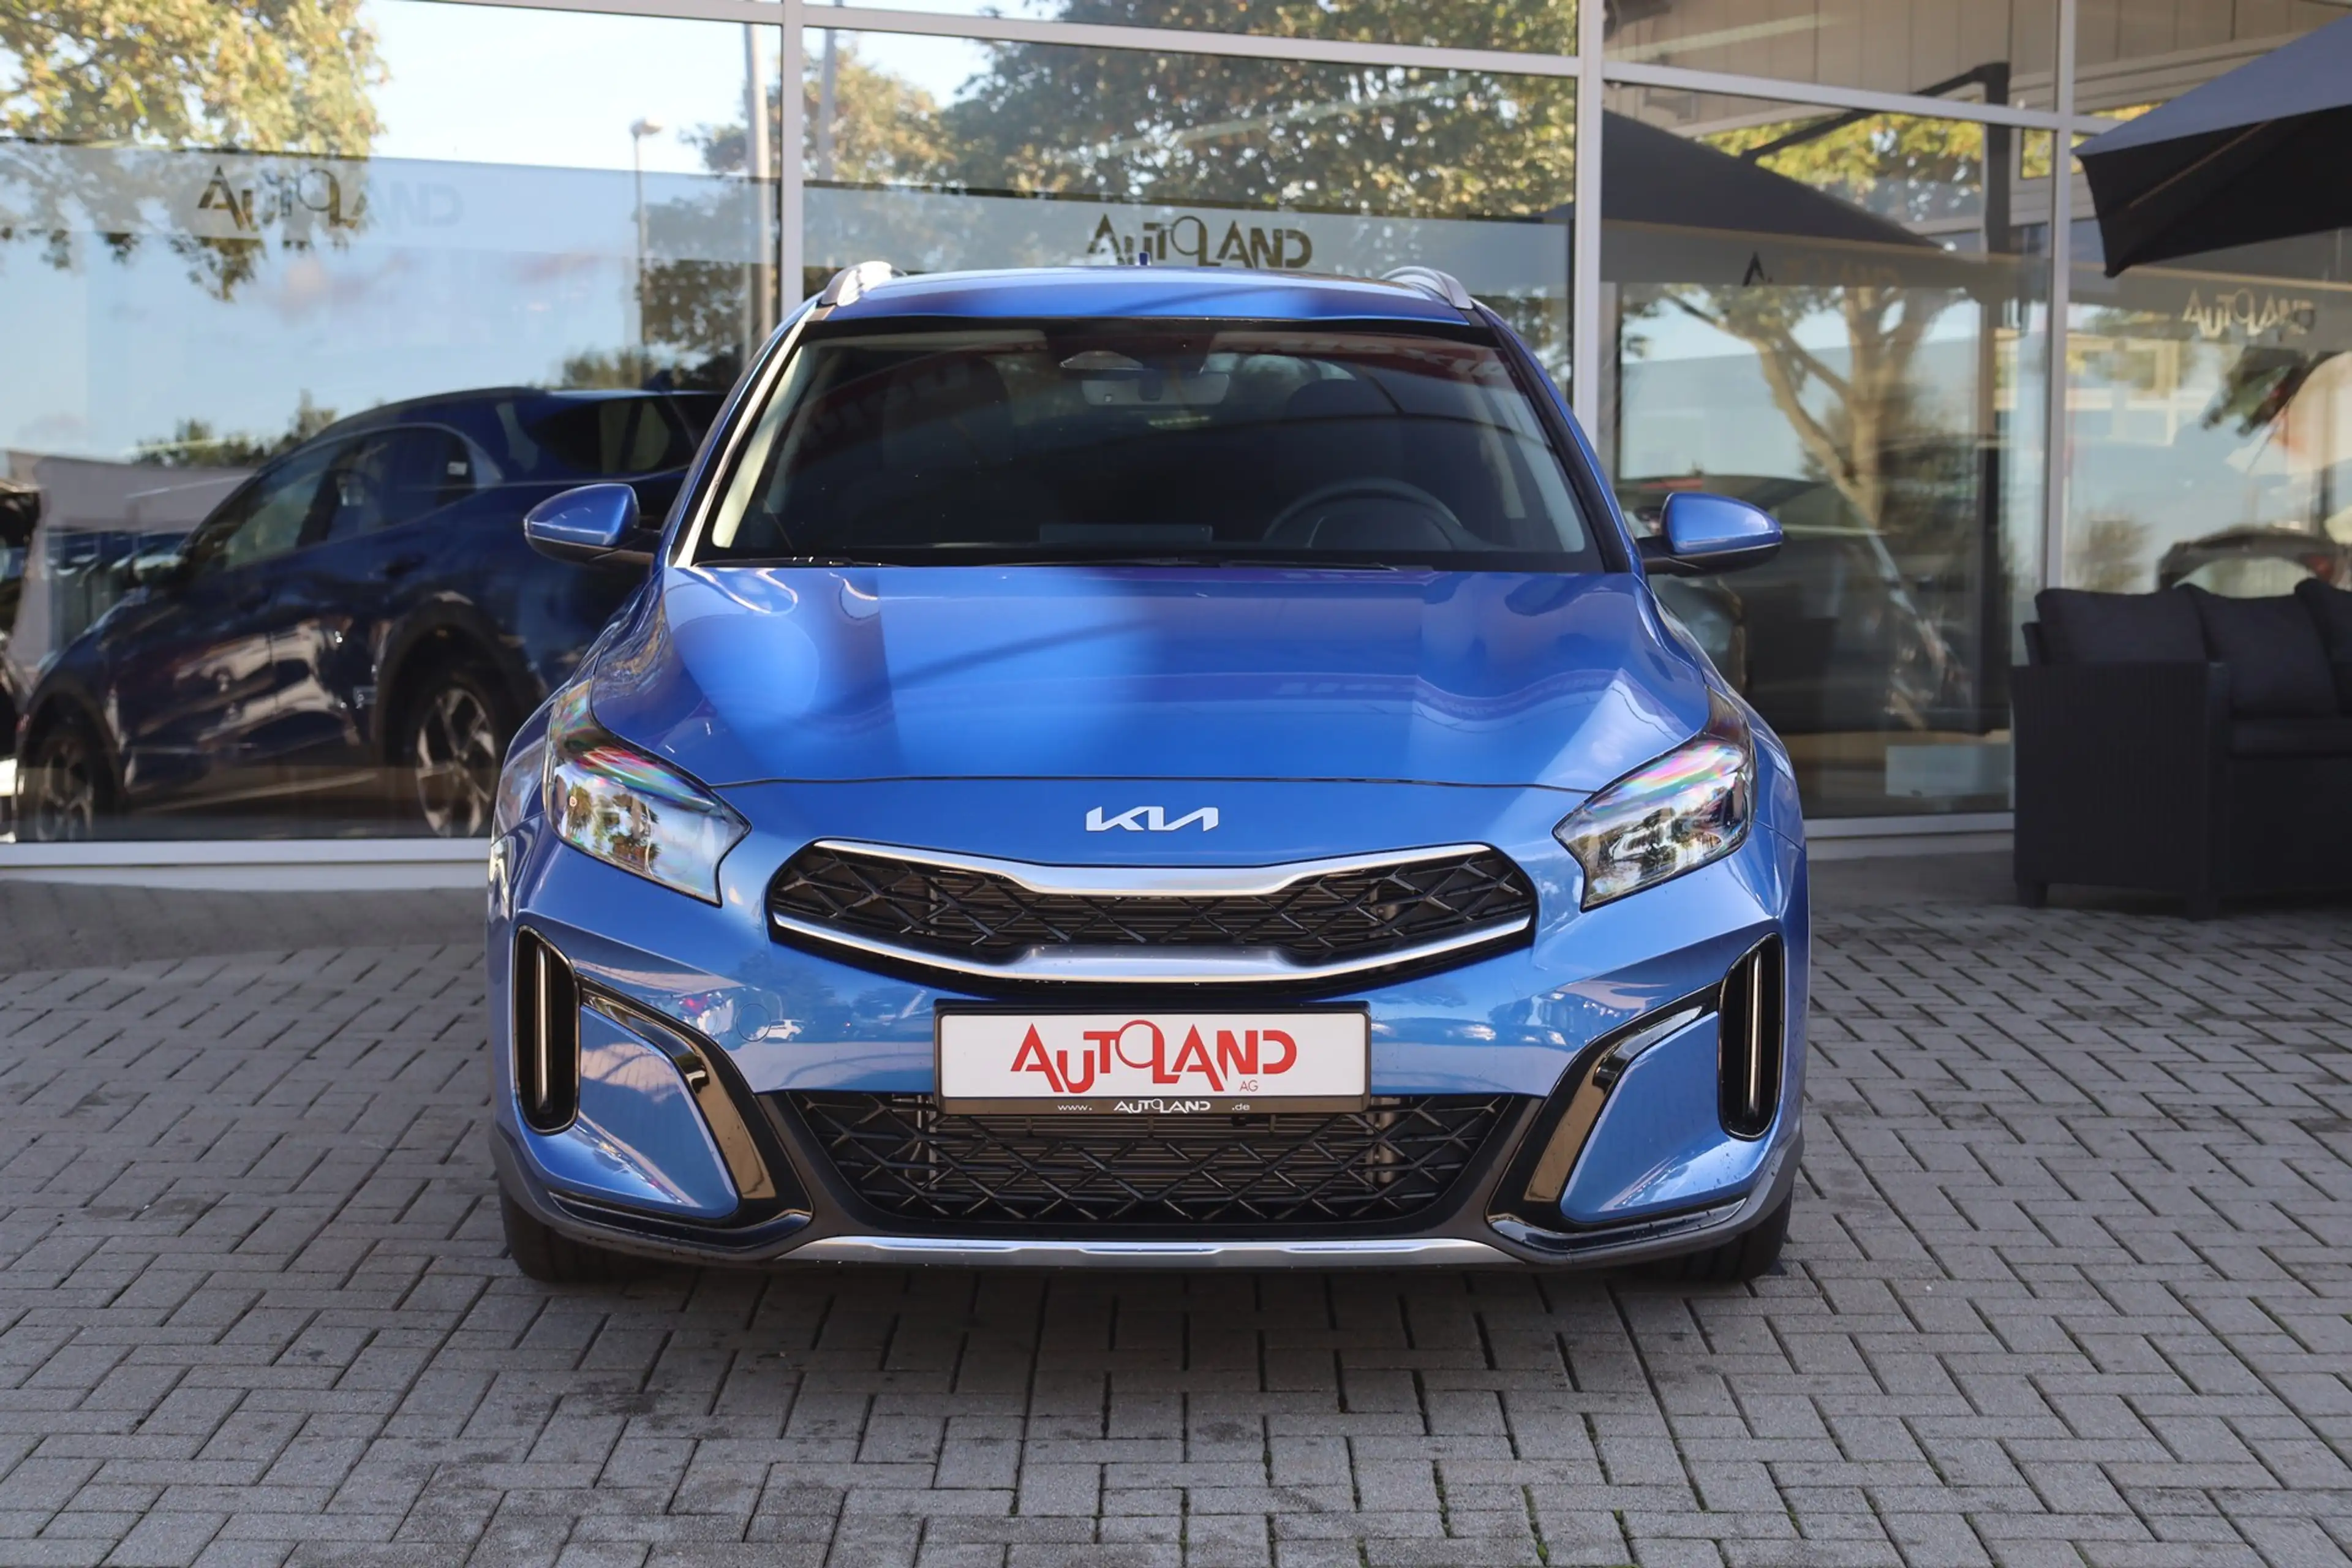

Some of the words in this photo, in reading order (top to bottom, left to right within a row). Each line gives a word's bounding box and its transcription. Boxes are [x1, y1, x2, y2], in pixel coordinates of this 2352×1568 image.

[1086, 806, 1219, 832] KIA
[1010, 1019, 1297, 1093] AUTOLAND
[1240, 1080, 1259, 1092] AG
[1113, 1098, 1212, 1114] AUTOLAND
